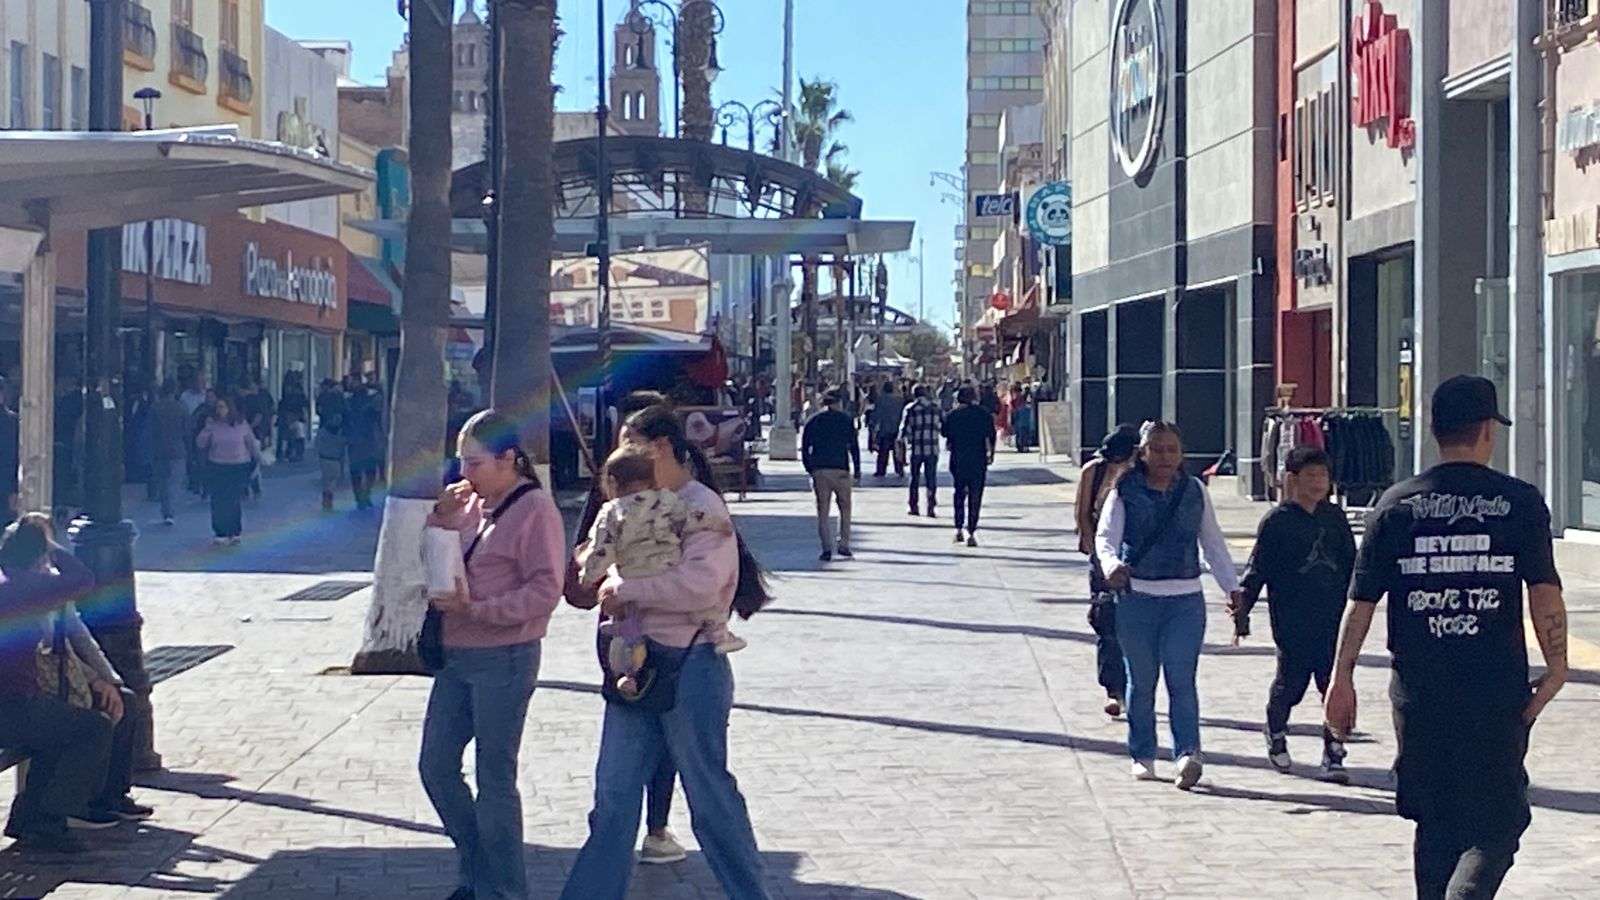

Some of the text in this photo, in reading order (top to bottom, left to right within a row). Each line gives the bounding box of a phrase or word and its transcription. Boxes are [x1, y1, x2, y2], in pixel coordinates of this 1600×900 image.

[1414, 534, 1491, 553] BEYOND
[1397, 555, 1515, 575] THE SURFACE
[1407, 587, 1501, 612] ABOVE THE
